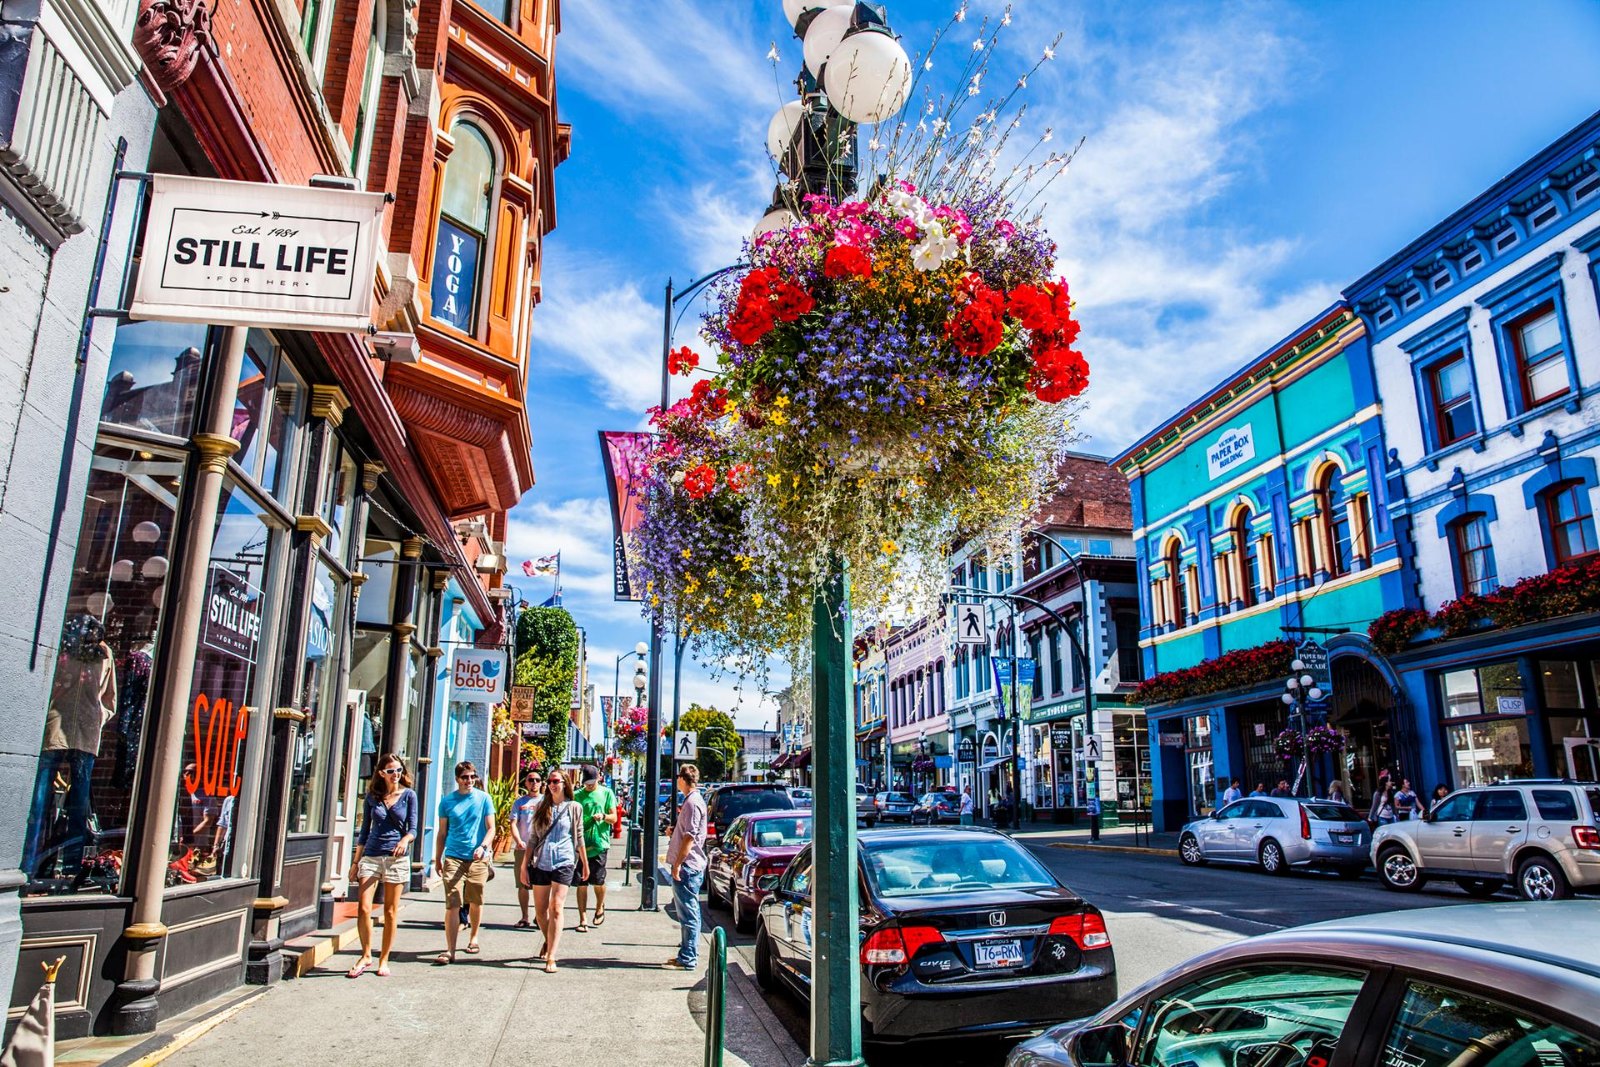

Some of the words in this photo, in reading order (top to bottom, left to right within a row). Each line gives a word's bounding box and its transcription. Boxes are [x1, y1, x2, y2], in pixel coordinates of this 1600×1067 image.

[232, 224, 260, 235] Est.
[267, 228, 300, 238] 1984
[174, 237, 265, 269] STILL
[276, 244, 349, 275] LIFE
[217, 275, 250, 283] FOR
[266, 279, 299, 287] HER
[442, 233, 465, 315] YOGA
[1211, 445, 1232, 464] PAPER
[1234, 434, 1249, 450] BOX
[615, 535, 627, 593] Victoria
[210, 594, 238, 632] STILL
[238, 608, 261, 642] LIFE
[456, 659, 481, 677] hip
[455, 673, 496, 693] baby
[1502, 699, 1522, 710] CUSP
